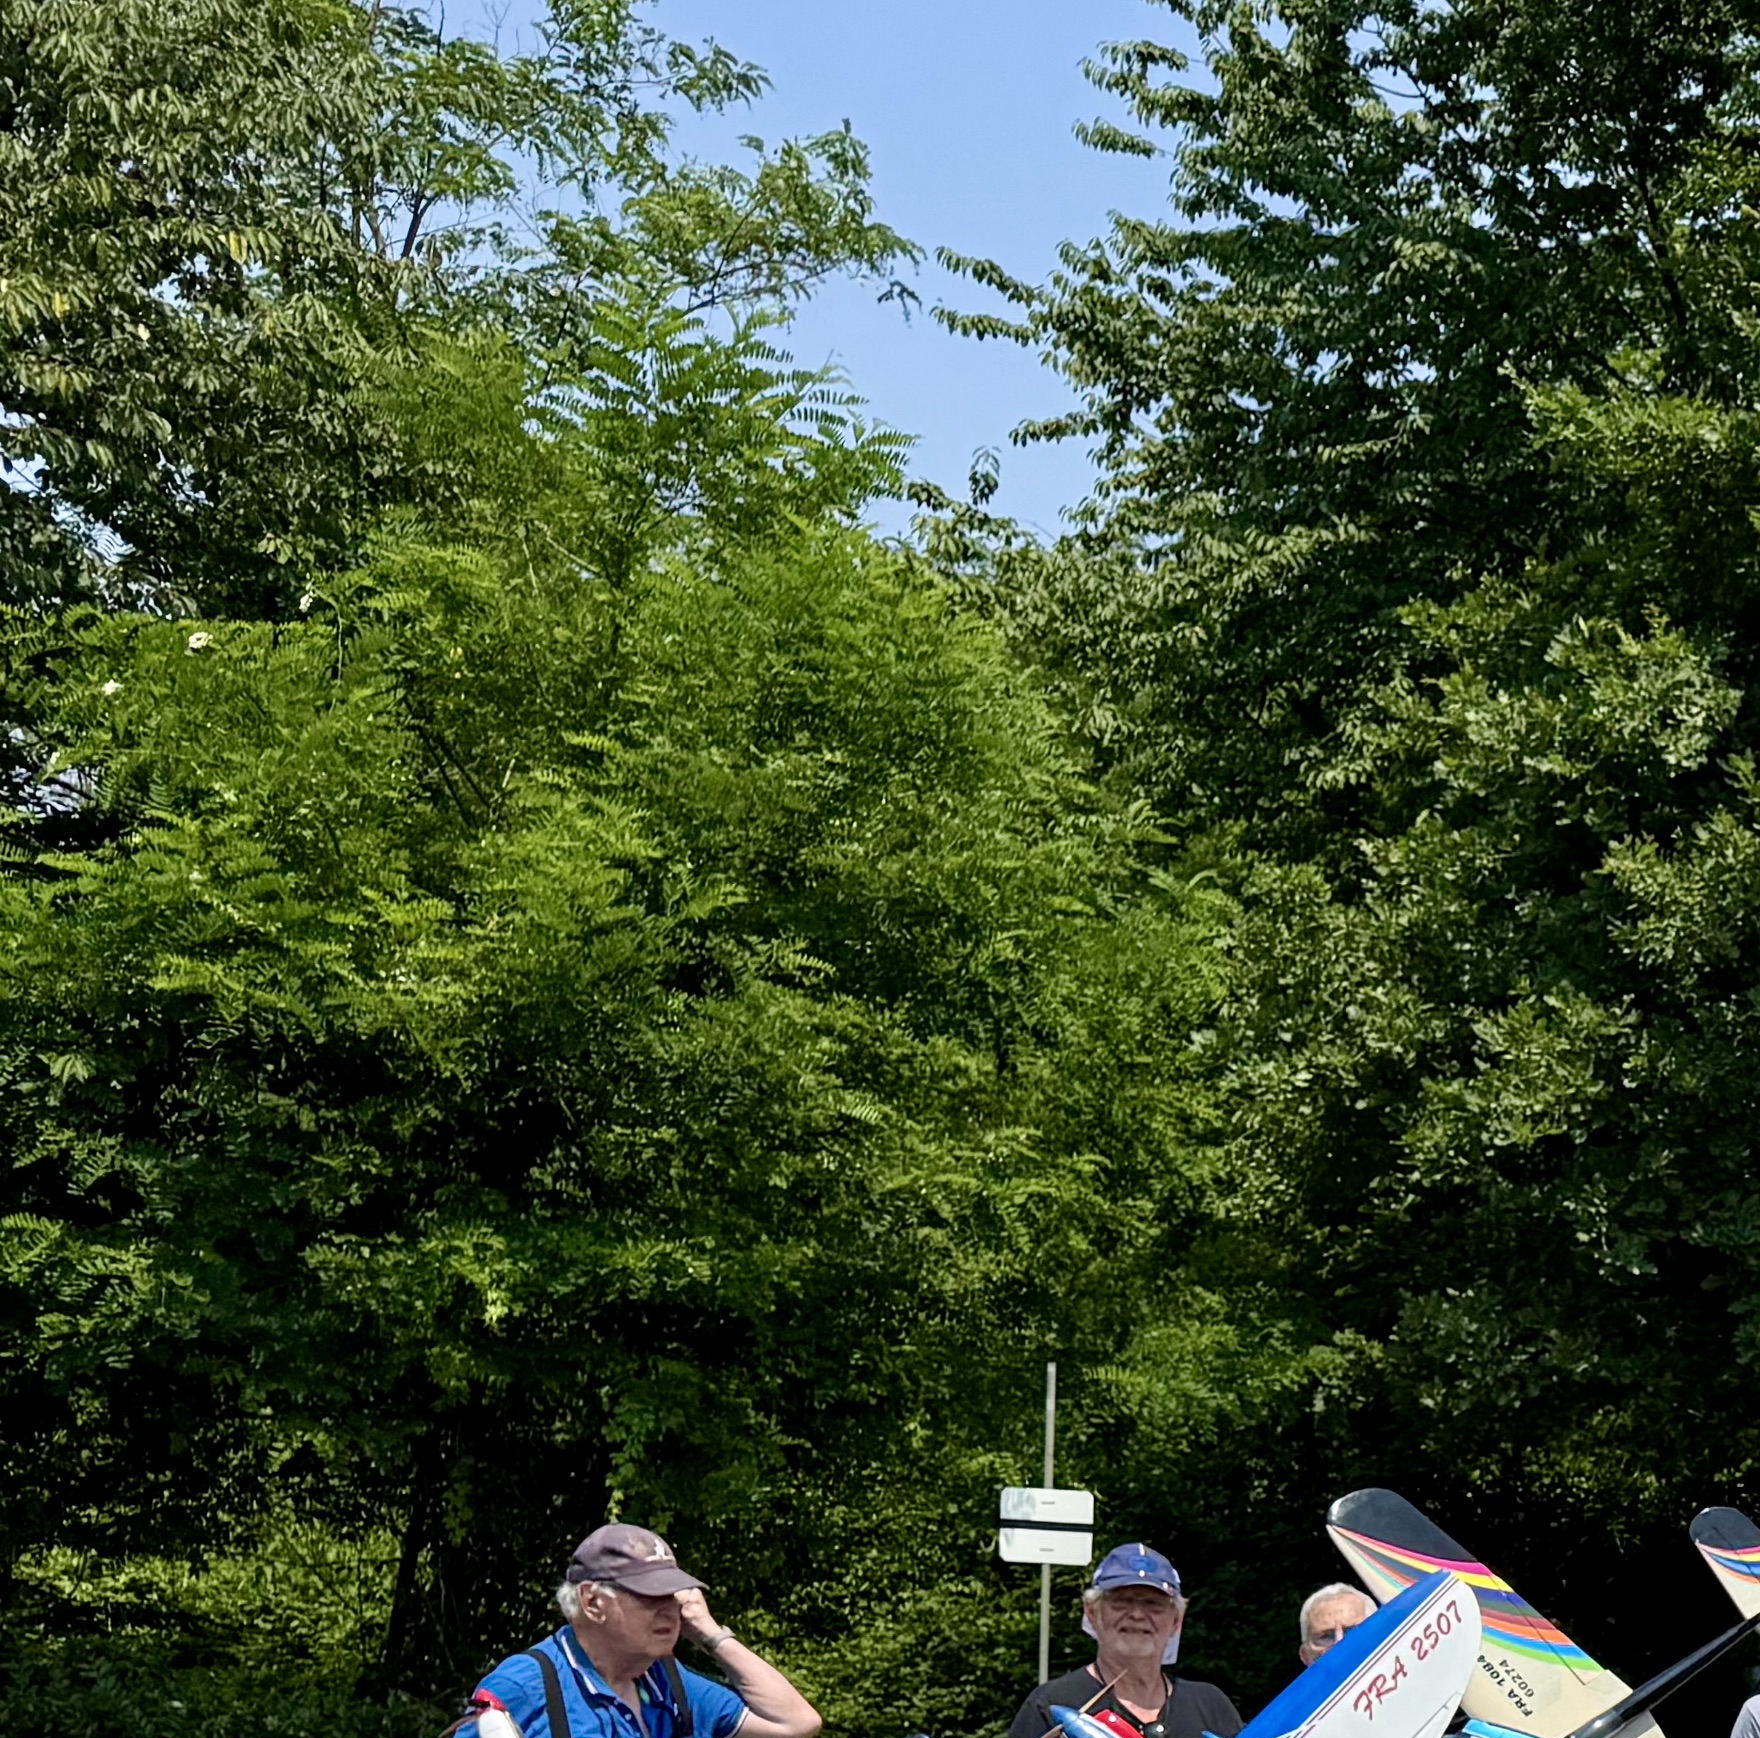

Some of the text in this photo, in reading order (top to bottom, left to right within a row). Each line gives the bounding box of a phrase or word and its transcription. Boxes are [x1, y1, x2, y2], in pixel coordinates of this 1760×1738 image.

[1352, 1599, 1463, 1721] FRA 2507
[1507, 1687, 1534, 1718] FRA
